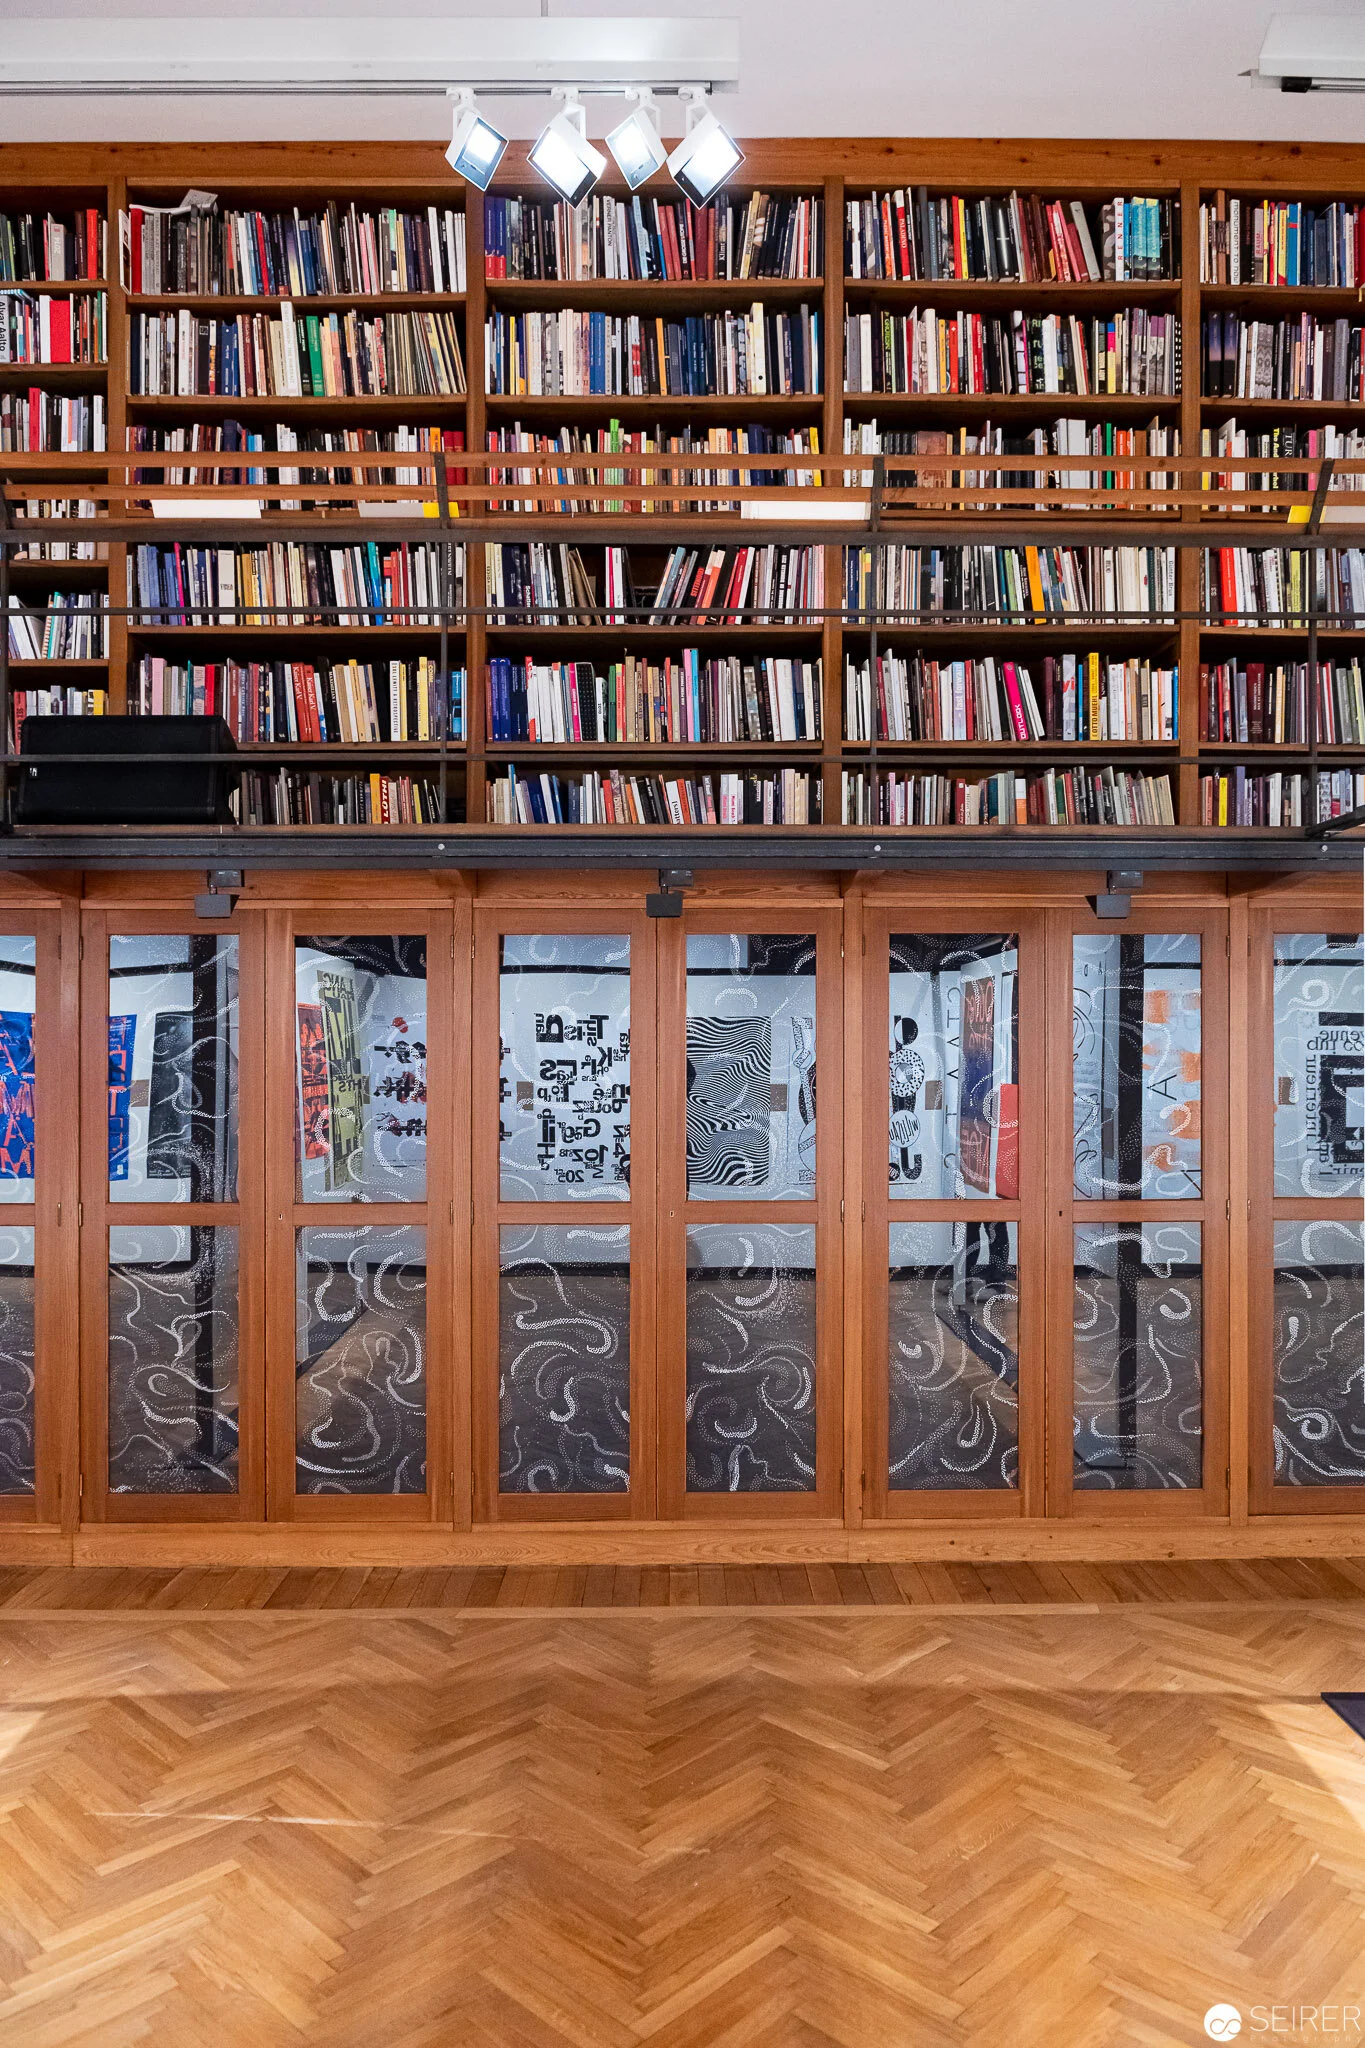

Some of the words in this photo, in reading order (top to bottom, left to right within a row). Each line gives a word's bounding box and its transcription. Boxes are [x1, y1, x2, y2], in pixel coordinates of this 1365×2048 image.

[899, 218, 907, 248] PALADINO
[53, 237, 62, 254] 2014
[718, 243, 726, 261] Klimt
[292, 666, 300, 683] Kaiser
[955, 664, 964, 694] forward
[306, 677, 314, 693] Kaiser
[955, 695, 963, 710] fast
[1091, 695, 1099, 716] MUEHL
[1015, 704, 1026, 739] OUTLOOK
[1091, 717, 1099, 733] OTTO
